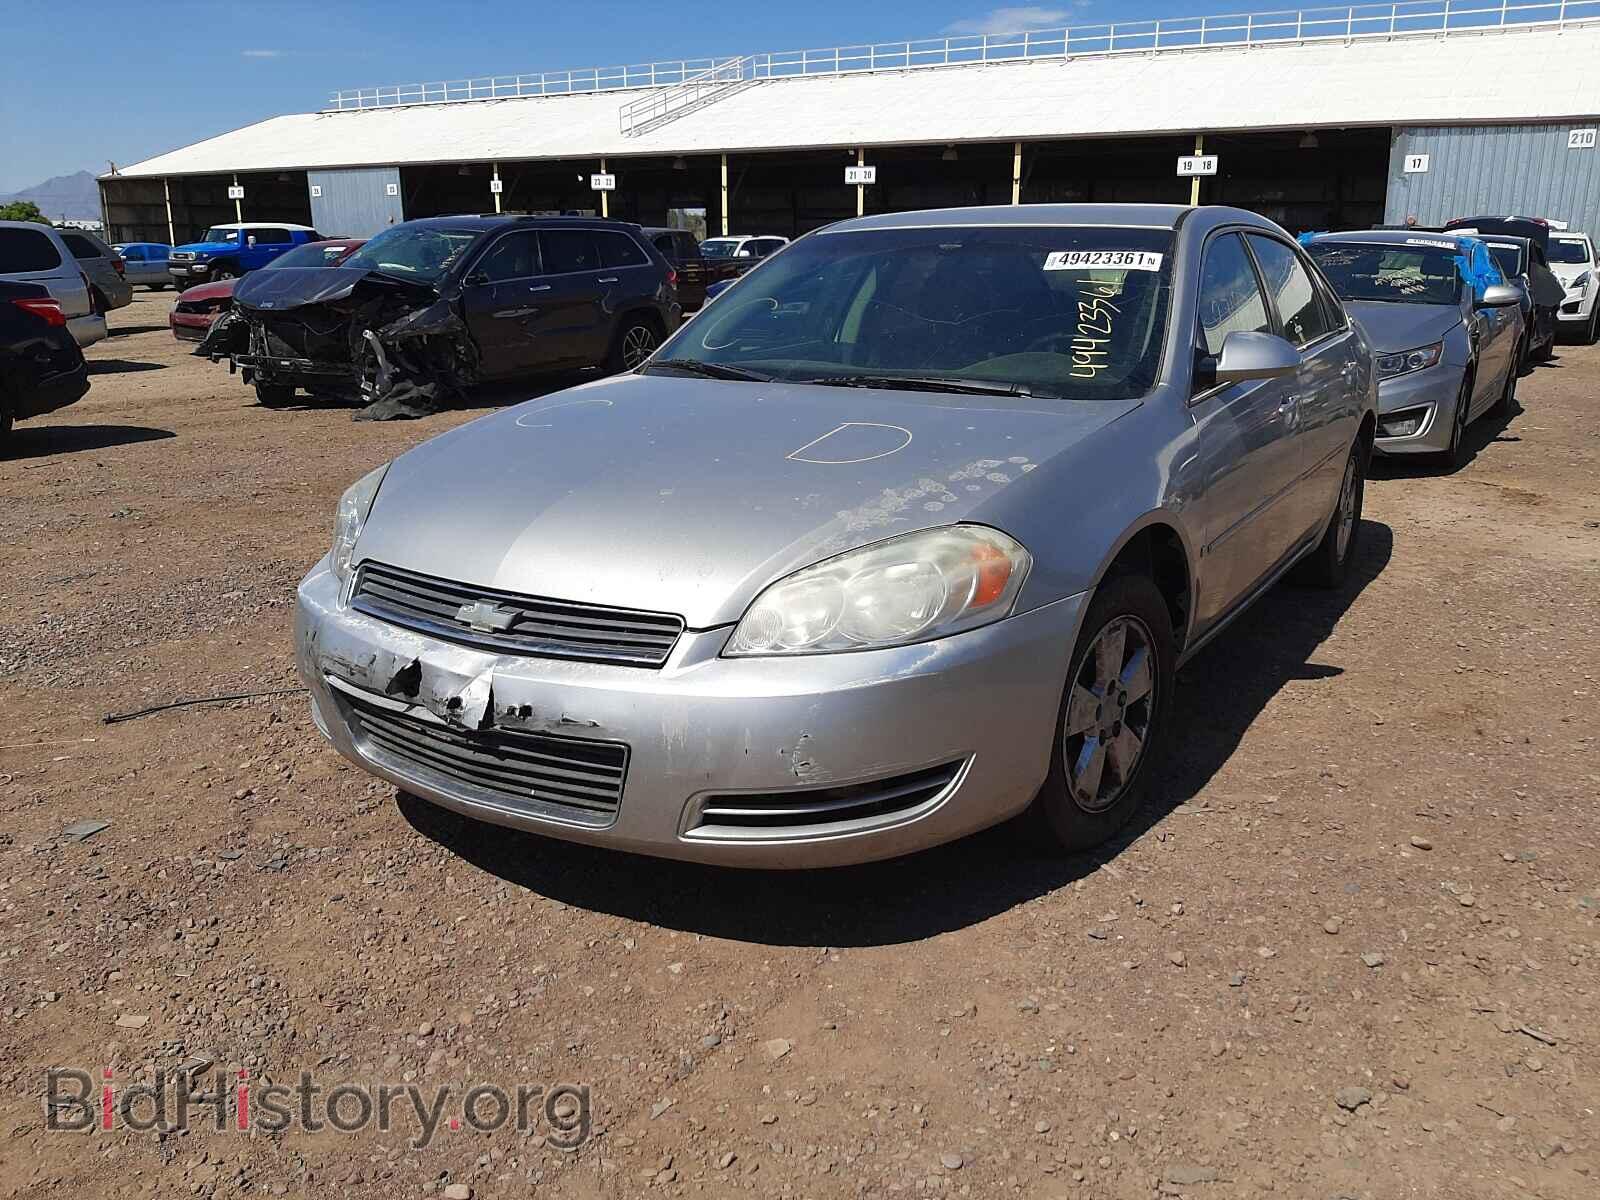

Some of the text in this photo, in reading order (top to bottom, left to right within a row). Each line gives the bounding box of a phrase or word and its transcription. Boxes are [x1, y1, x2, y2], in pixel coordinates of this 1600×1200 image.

[1570, 132, 1593, 144] 210
[1183, 160, 1212, 171] 19 18
[1412, 158, 1421, 169] 17
[849, 170, 872, 180] 21 20
[1058, 251, 1145, 265] 49423361
[1146, 257, 1156, 265] N
